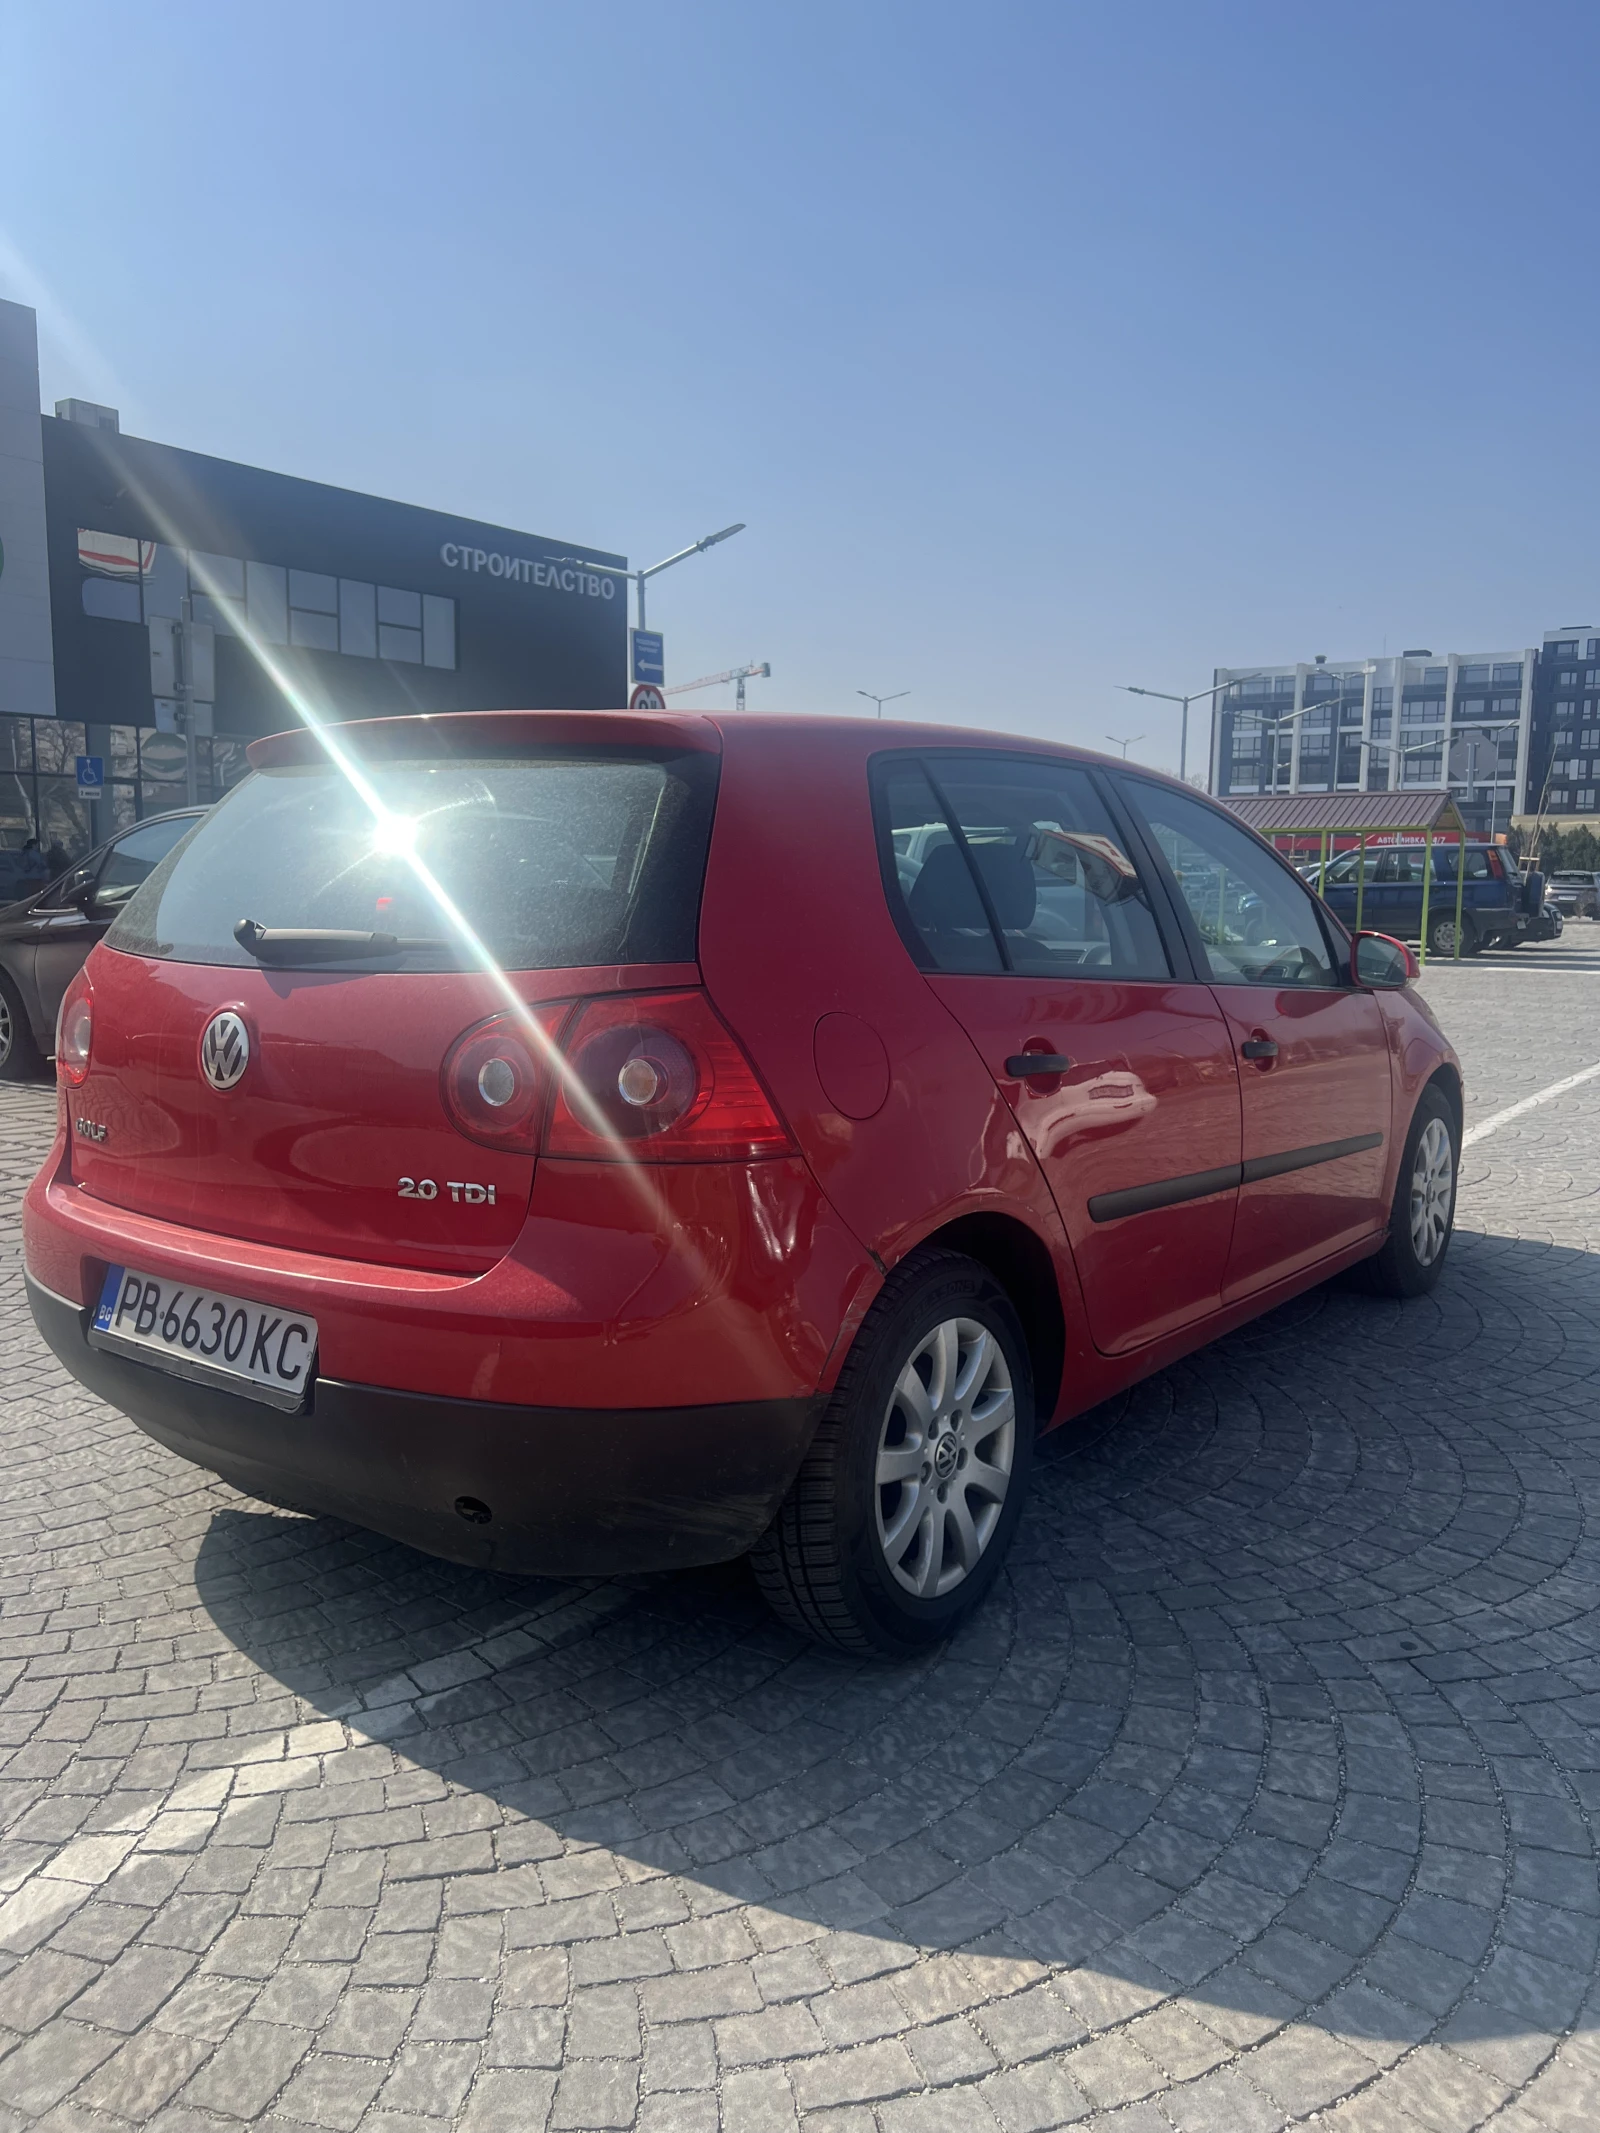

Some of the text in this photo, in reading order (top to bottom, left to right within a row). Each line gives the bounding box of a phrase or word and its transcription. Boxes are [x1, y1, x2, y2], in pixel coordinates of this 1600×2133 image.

[440, 542, 616, 600] СТРОИТЕЛСТВО
[76, 1117, 107, 1142] GOLF
[446, 1181, 496, 1205] TDI
[98, 1304, 113, 1322] BG
